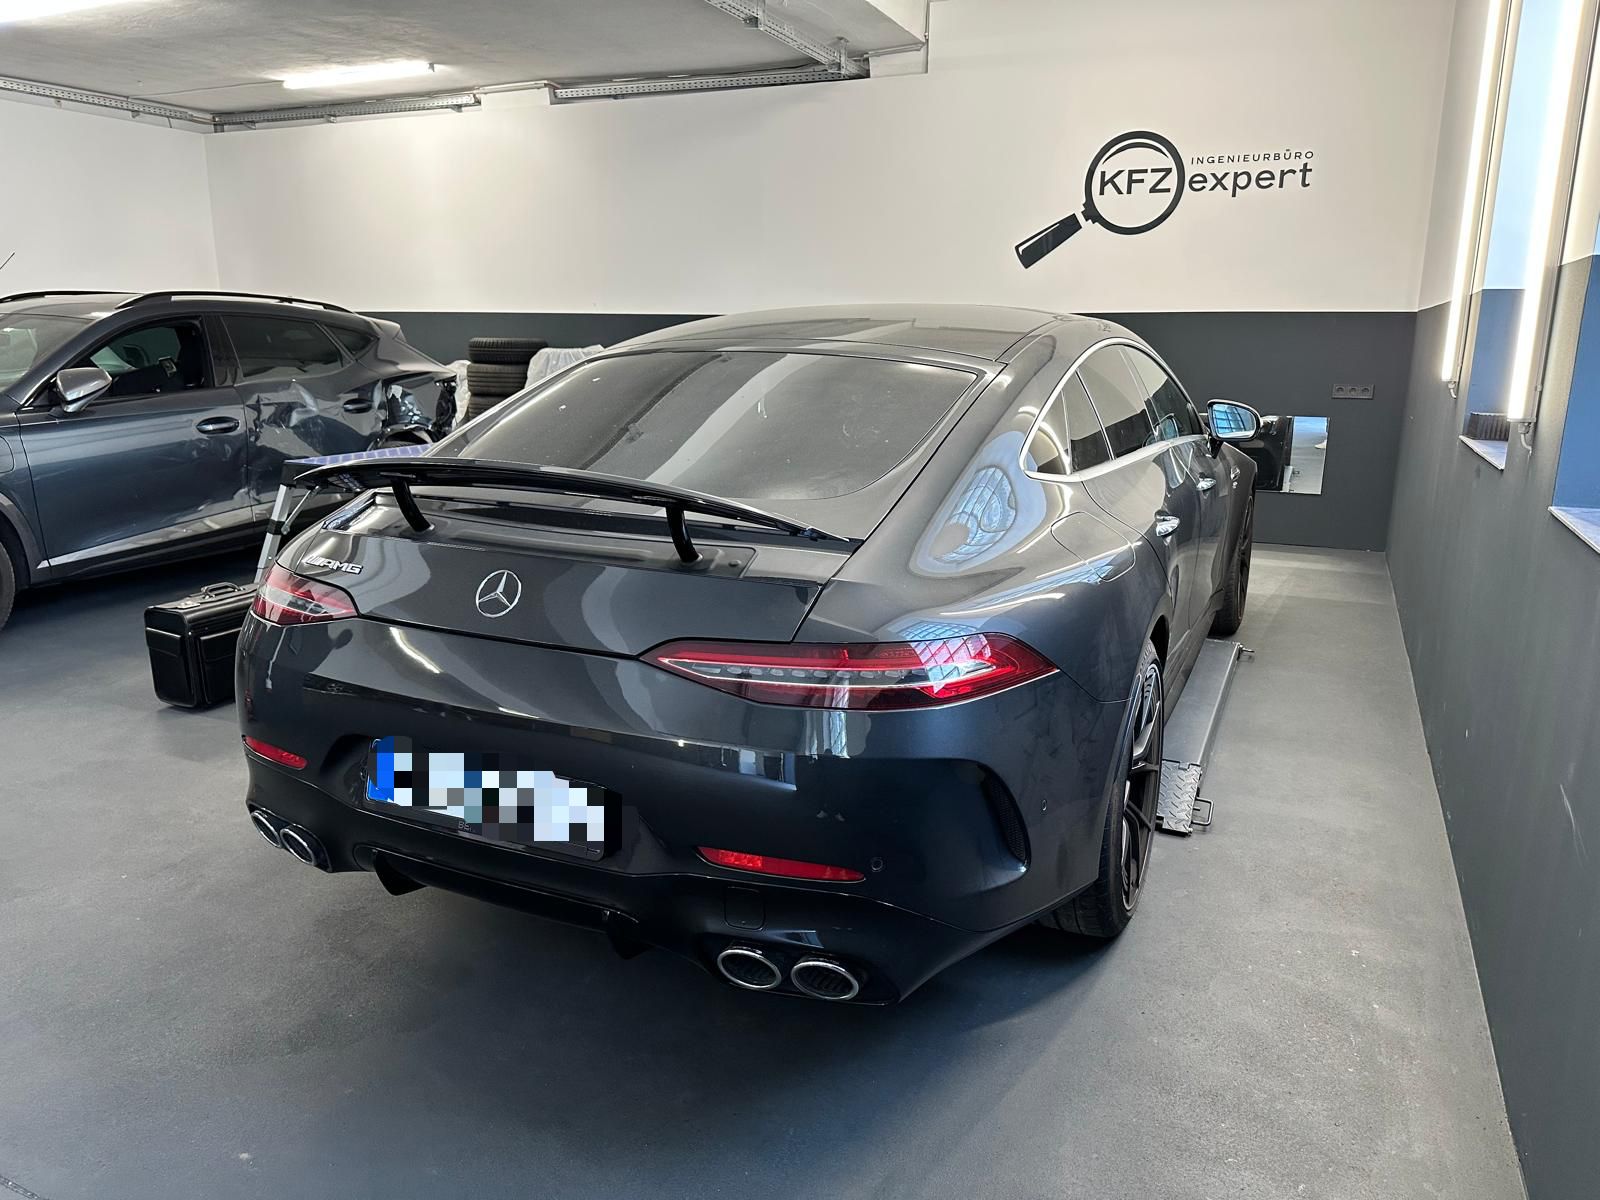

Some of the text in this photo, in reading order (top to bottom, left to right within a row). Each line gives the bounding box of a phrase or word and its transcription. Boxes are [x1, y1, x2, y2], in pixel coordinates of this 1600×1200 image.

[1191, 149, 1314, 165] INGENIEURBÜRO
[1099, 162, 1313, 198] KFZ expert
[317, 556, 363, 575] AMG
